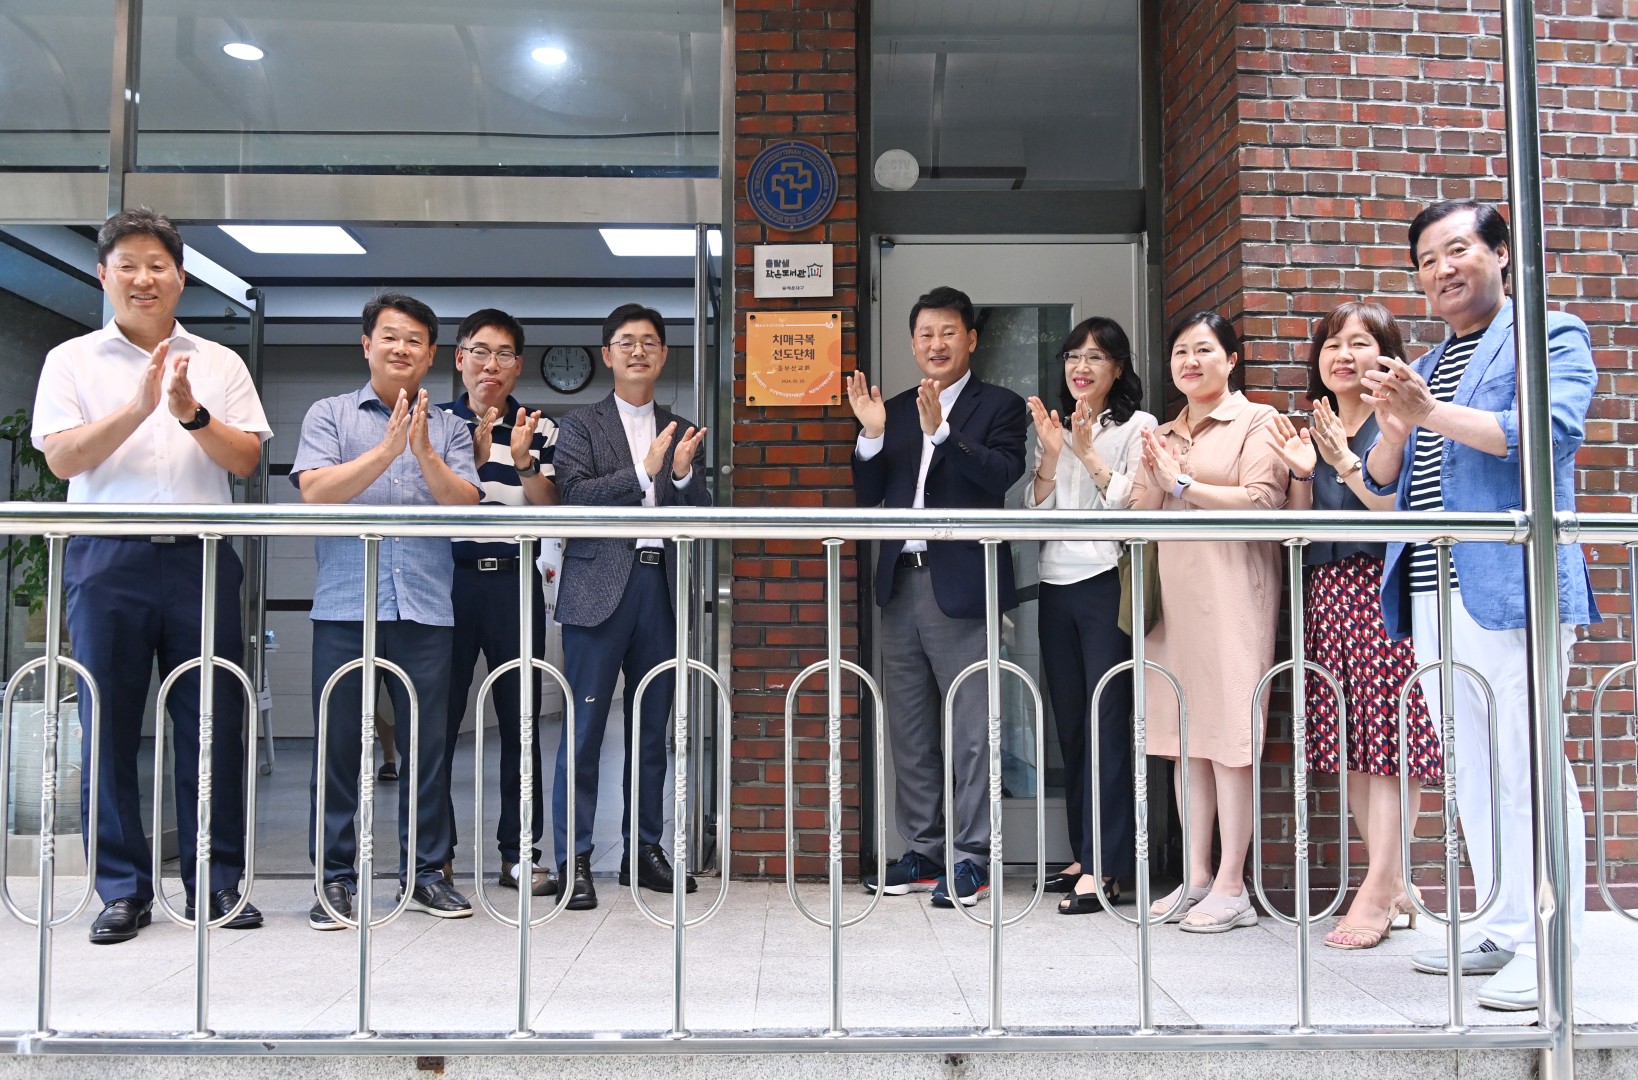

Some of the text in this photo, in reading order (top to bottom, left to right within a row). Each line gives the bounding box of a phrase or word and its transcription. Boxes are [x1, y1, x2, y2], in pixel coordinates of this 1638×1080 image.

[766, 269, 806, 278] 작은도서관
[772, 334, 815, 346] 치매극복
[772, 349, 815, 360] 선도단체
